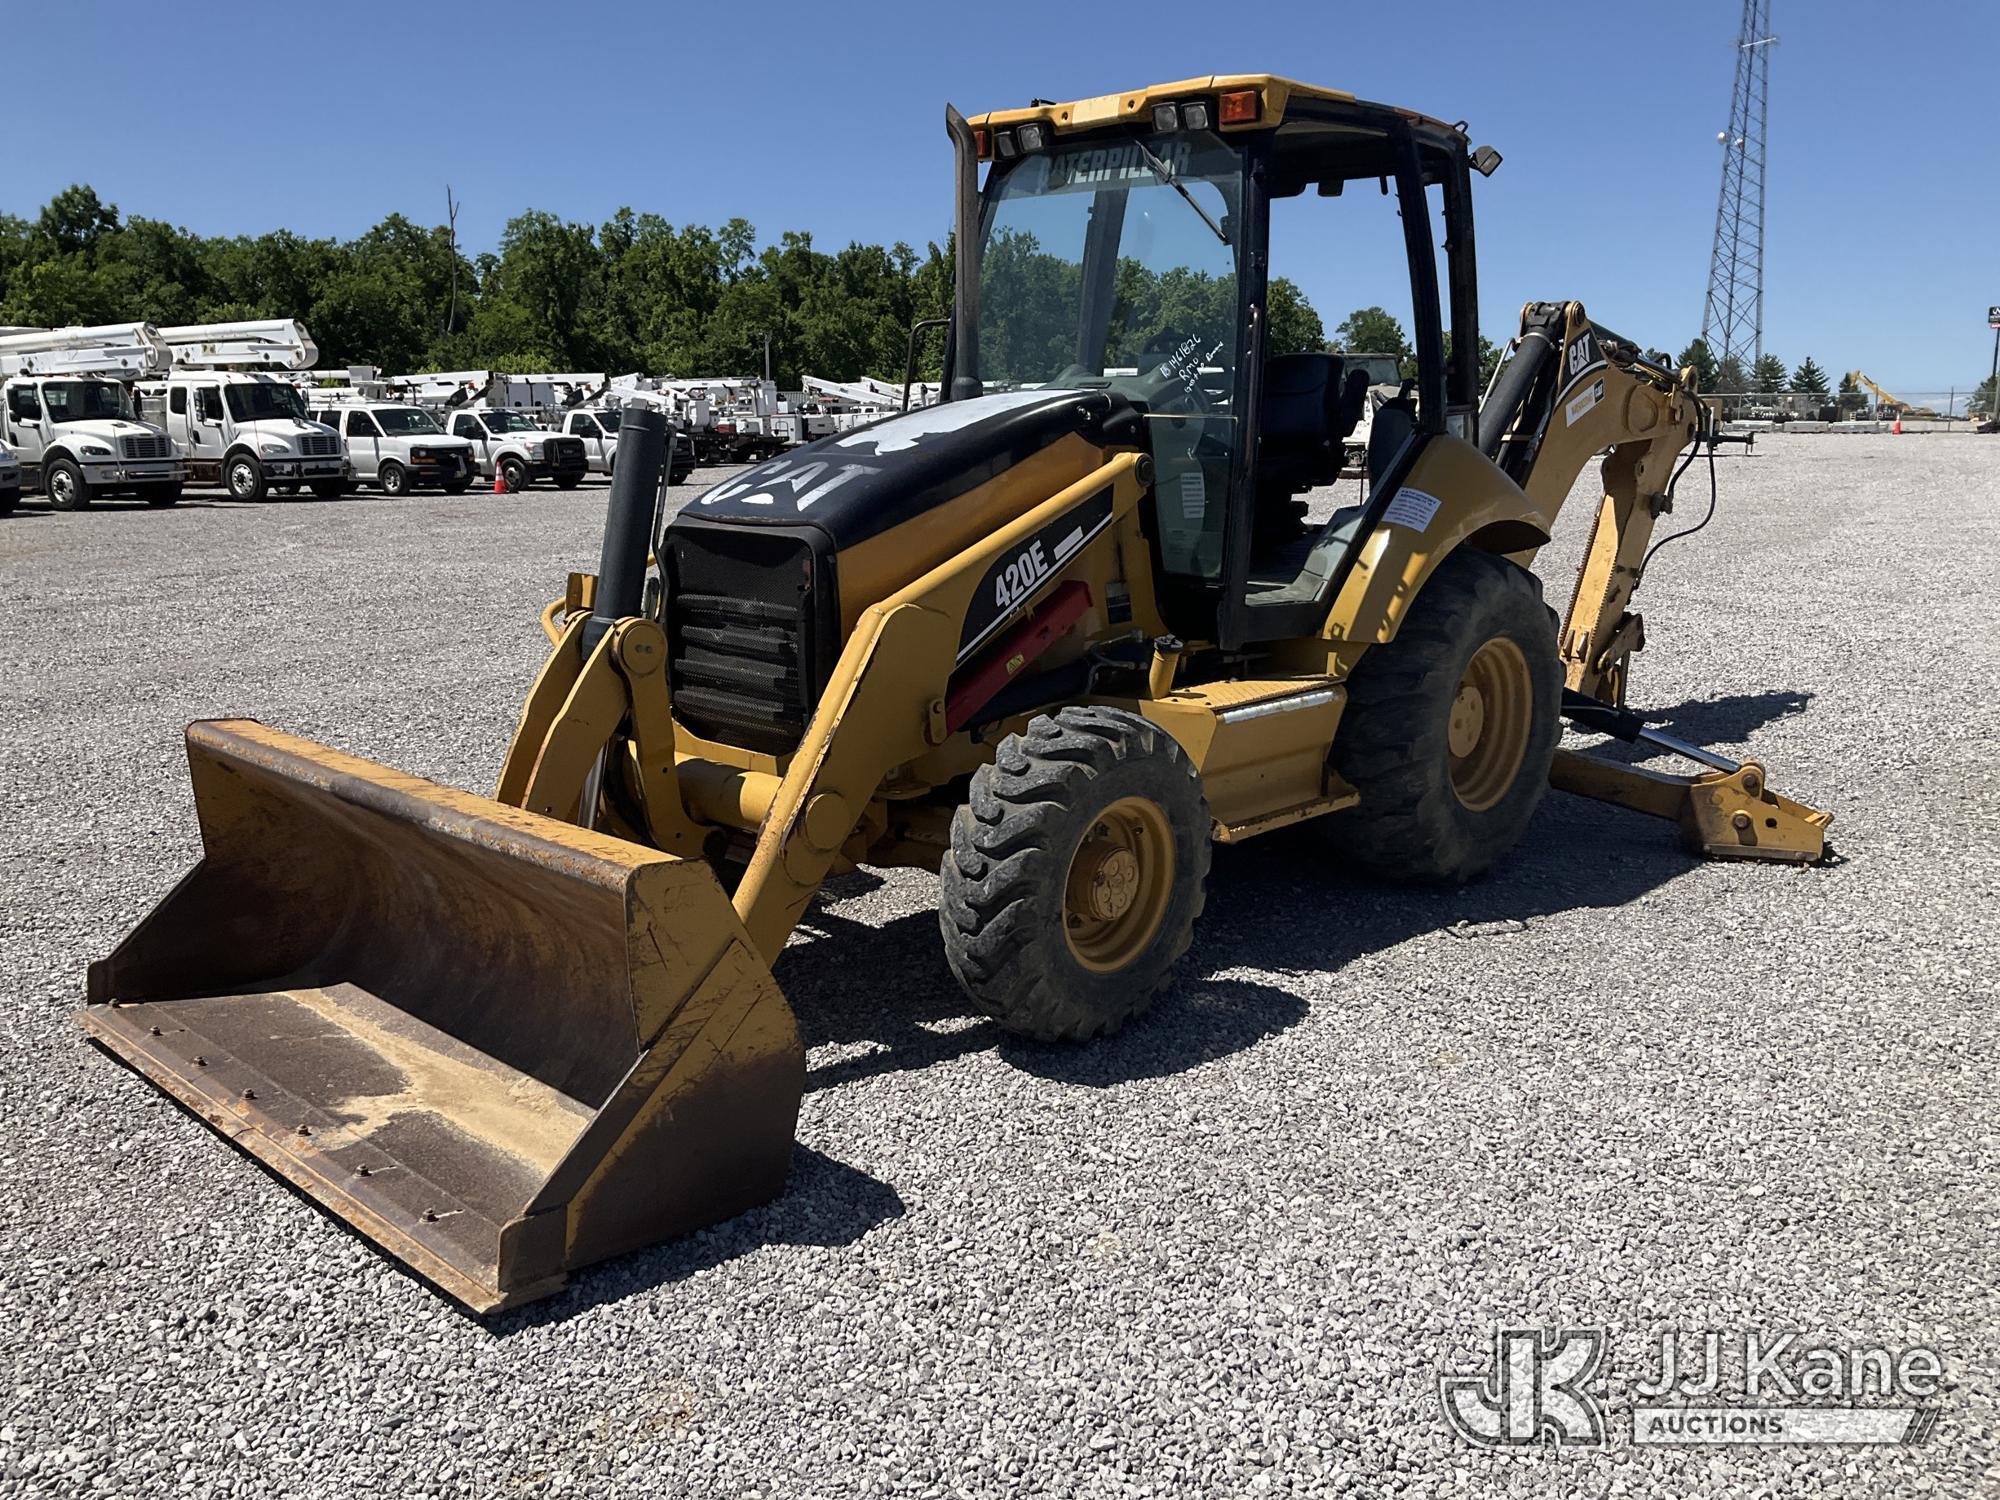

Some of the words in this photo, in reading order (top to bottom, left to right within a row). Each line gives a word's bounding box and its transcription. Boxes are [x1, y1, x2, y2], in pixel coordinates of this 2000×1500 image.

[1569, 333, 1590, 375] CAT
[701, 460, 883, 511] CAT
[995, 540, 1049, 607] 420E
